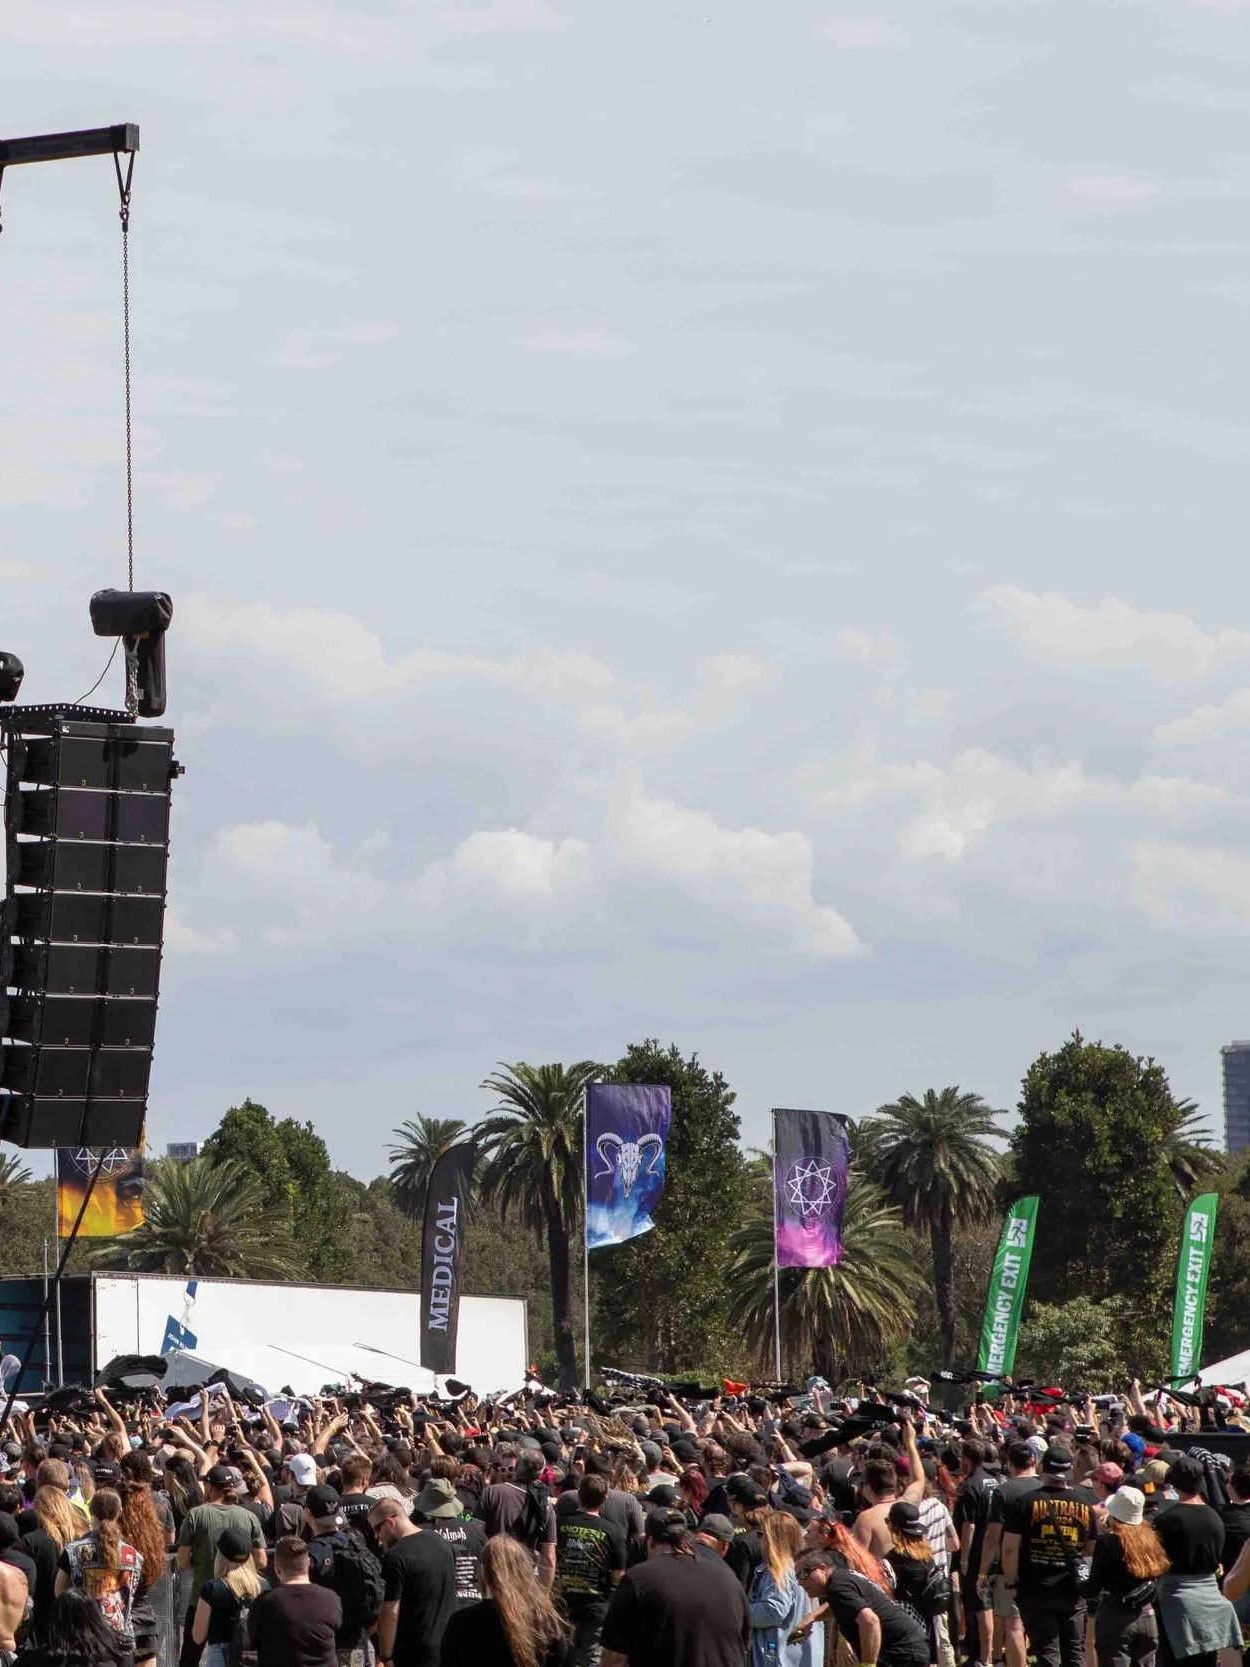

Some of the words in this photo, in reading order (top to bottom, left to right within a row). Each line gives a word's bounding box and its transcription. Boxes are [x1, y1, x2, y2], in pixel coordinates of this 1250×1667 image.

[428, 1196, 458, 1332] MEDICAL
[1001, 1252, 1022, 1289] EXIT
[1186, 1246, 1204, 1283] EXIT
[1177, 1284, 1199, 1377] EMERGENCY
[1031, 1499, 1091, 1531] AUTRALIA
